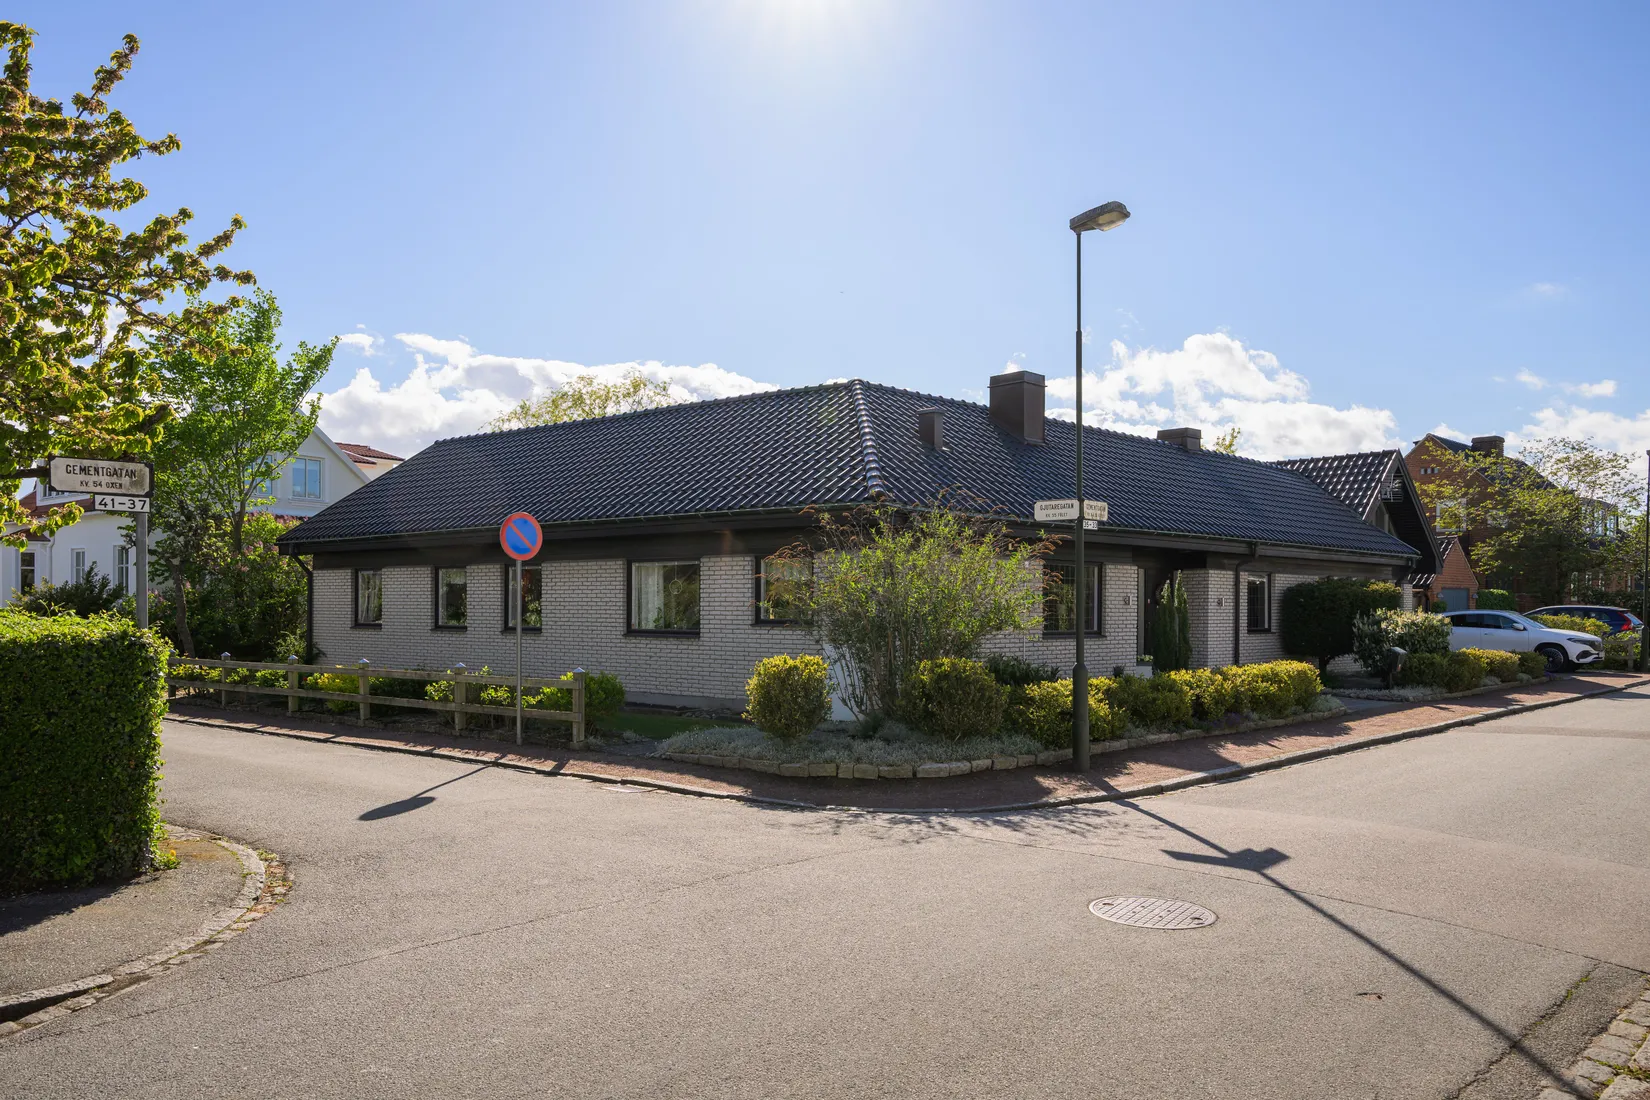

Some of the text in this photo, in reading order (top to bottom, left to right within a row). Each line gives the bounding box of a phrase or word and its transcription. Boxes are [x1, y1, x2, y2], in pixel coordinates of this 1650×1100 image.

[93, 481, 103, 489] 54
[105, 482, 123, 490] OXEN
[98, 497, 147, 511] 41-37
